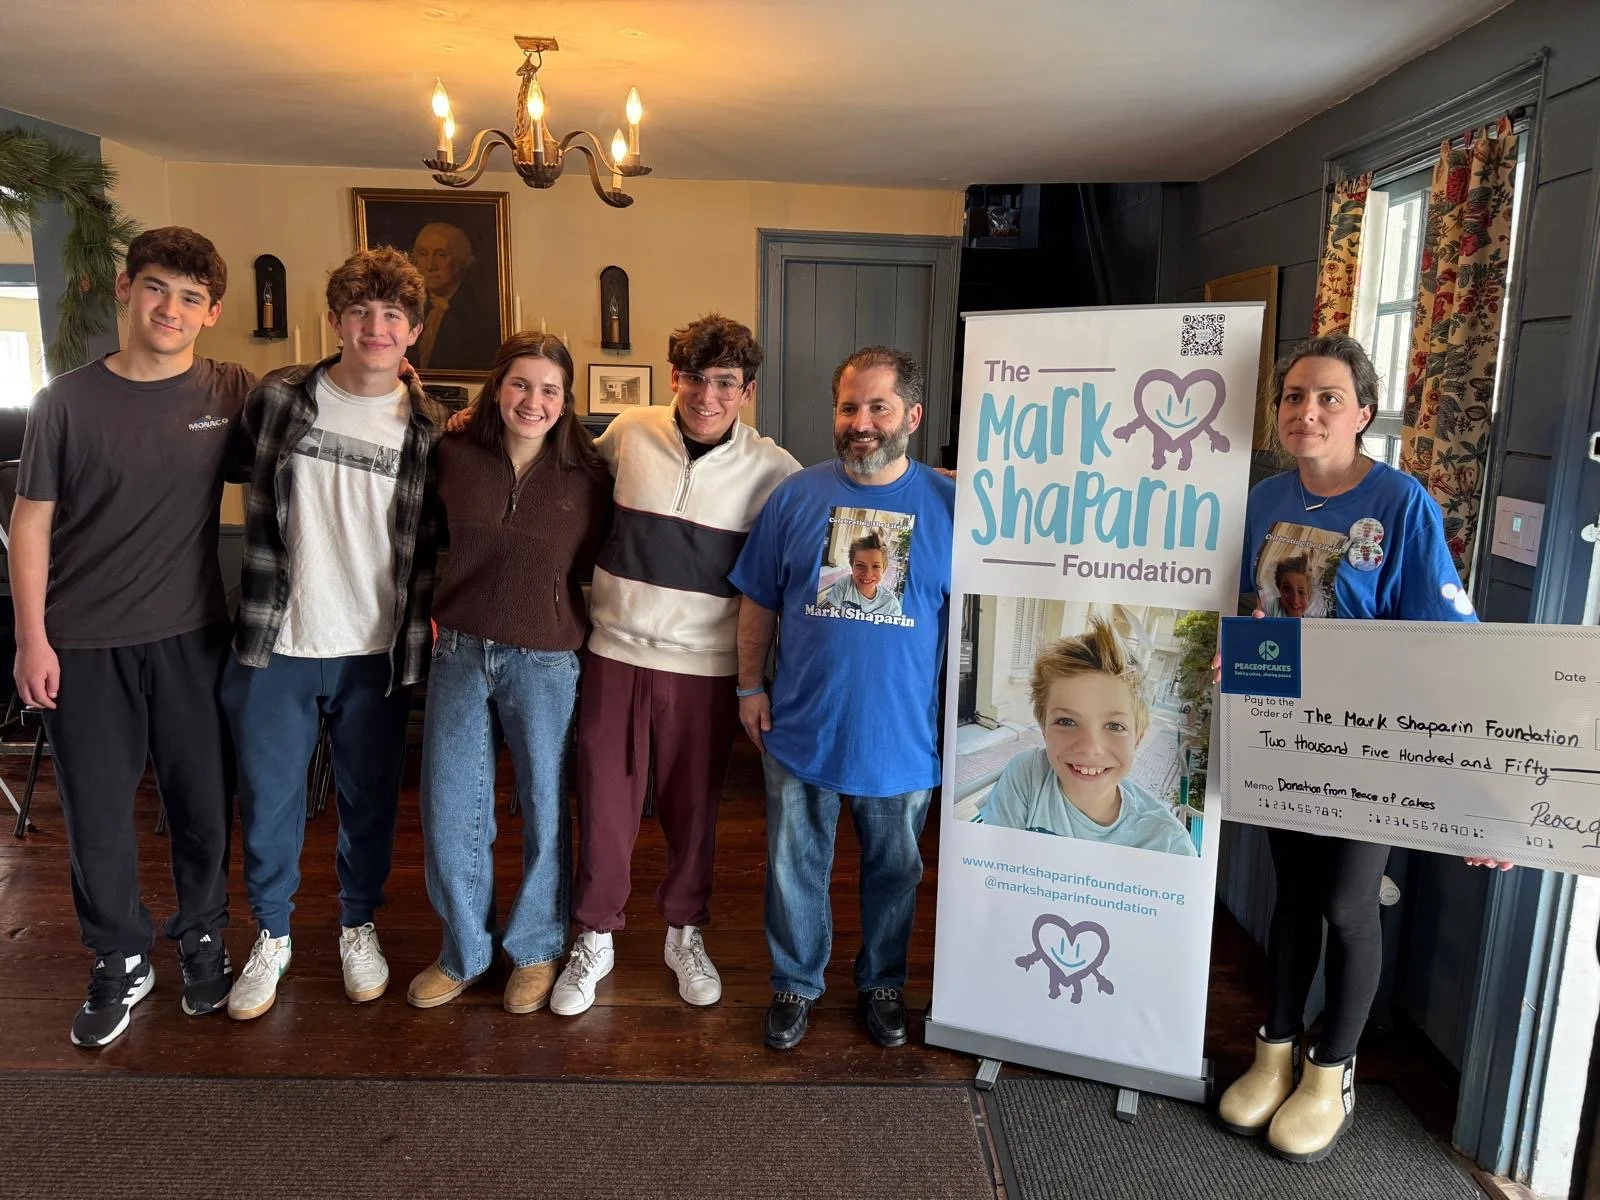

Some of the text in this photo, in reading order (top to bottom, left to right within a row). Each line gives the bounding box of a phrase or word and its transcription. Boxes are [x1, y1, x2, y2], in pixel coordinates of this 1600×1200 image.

[984, 360, 1030, 382] The
[189, 418, 229, 430] MONACO
[977, 382, 1112, 465] Mark
[1062, 555, 1211, 585] Foundation
[805, 604, 915, 627] Mark Shaparin
[1554, 670, 1587, 683] Date
[1244, 694, 1295, 708] Pay to the
[1250, 707, 1294, 720] Order of
[1303, 707, 1580, 748] The Mark Shaparin Foundation
[1259, 730, 1550, 786] Two thousand Five Hundred and Fifty
[1244, 779, 1274, 792] Memo
[1277, 777, 1436, 810] Donation from Peace of Cakes
[962, 856, 1186, 906] www.markshaparinfoundation.org
[984, 875, 1158, 917] @markshaparinfoundation
